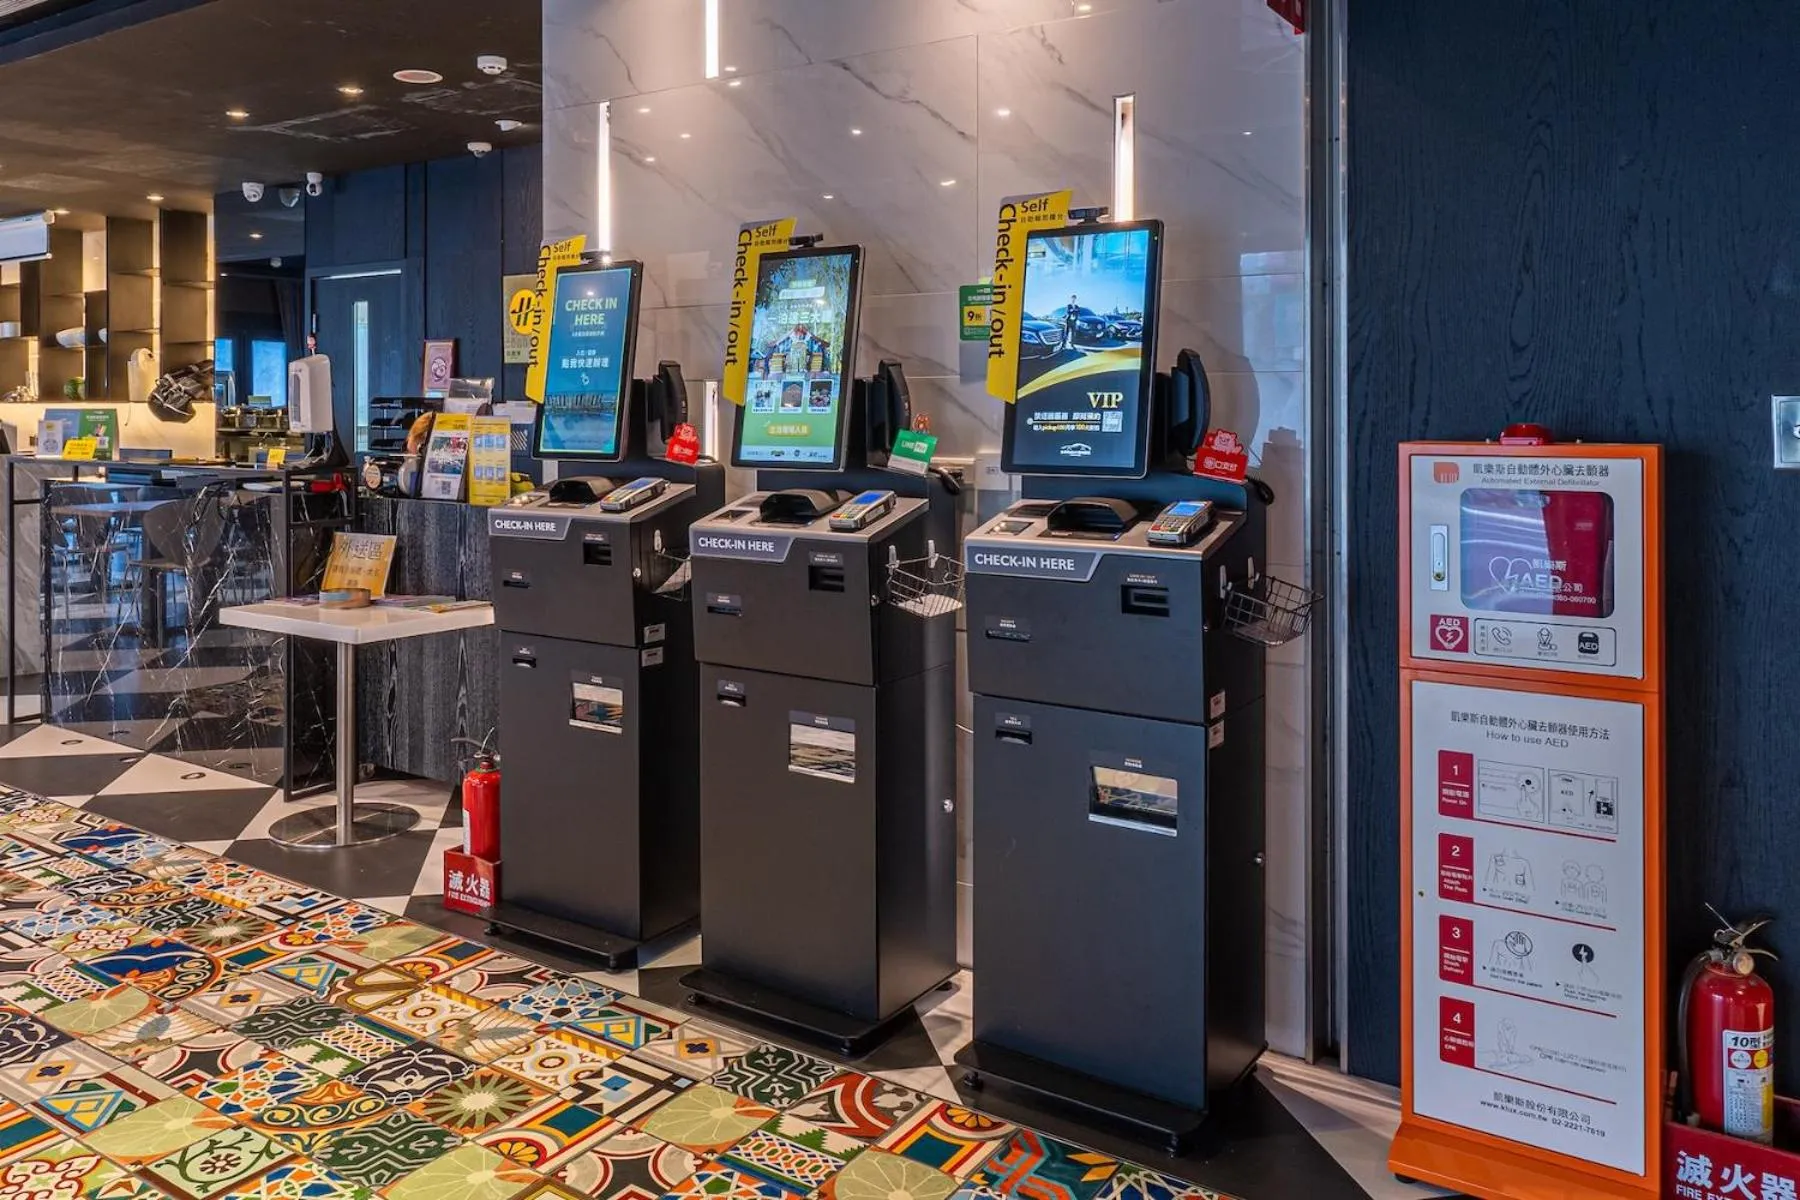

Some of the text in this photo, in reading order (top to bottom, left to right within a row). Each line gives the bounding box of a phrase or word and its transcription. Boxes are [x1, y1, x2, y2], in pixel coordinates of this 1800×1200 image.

[1021, 198, 1048, 213] Self
[755, 224, 777, 238] Self
[553, 241, 572, 253] Self
[989, 203, 1017, 358] Check-in/out
[565, 297, 618, 312] CHECK IN
[725, 228, 752, 366] Check-in/out
[529, 245, 551, 368] Check-in/out
[574, 313, 606, 326] HERE
[1087, 392, 1123, 408] VIP
[495, 519, 556, 532] CHECK-IN HERE
[698, 537, 775, 552] CHECK-IN HERE
[974, 553, 1075, 571] CHECK-IN HERE
[1522, 573, 1562, 589] AED
[1438, 617, 1460, 626] AED
[1579, 642, 1599, 650] AED
[1487, 730, 1568, 748] How to use AED
[1453, 765, 1458, 776] 1
[1452, 845, 1460, 856] 2
[449, 870, 490, 900] 滅火器
[1452, 926, 1460, 938] 3
[1453, 1013, 1461, 1024] 4
[1677, 1150, 1797, 1200] 滅火器
[1676, 1184, 1702, 1200] FIRE
